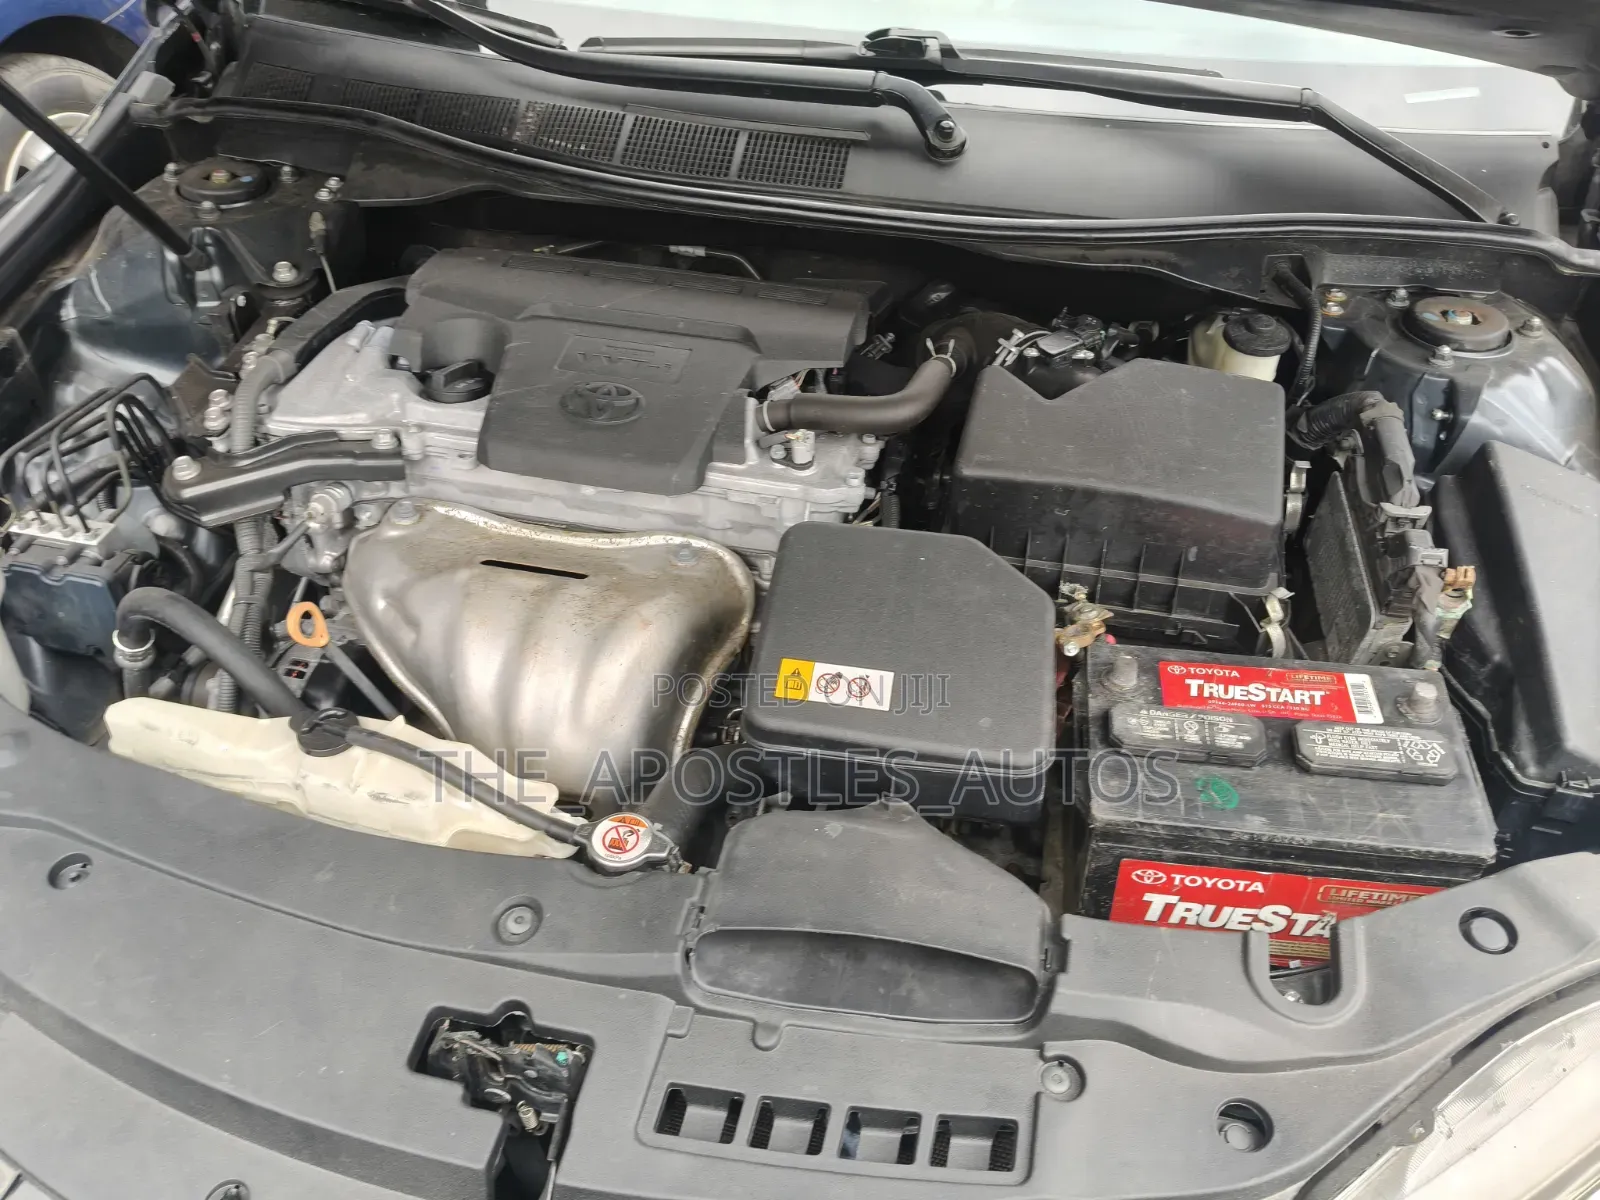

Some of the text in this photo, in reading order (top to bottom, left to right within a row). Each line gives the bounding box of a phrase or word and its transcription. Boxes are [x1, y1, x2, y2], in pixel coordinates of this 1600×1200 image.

[1188, 667, 1240, 678] TOYOTA
[1149, 709, 1190, 719] DANGER
[1198, 713, 1234, 724] POISON
[1170, 873, 1265, 894] TOYOTA
[1142, 892, 1337, 939] TRUESTA
